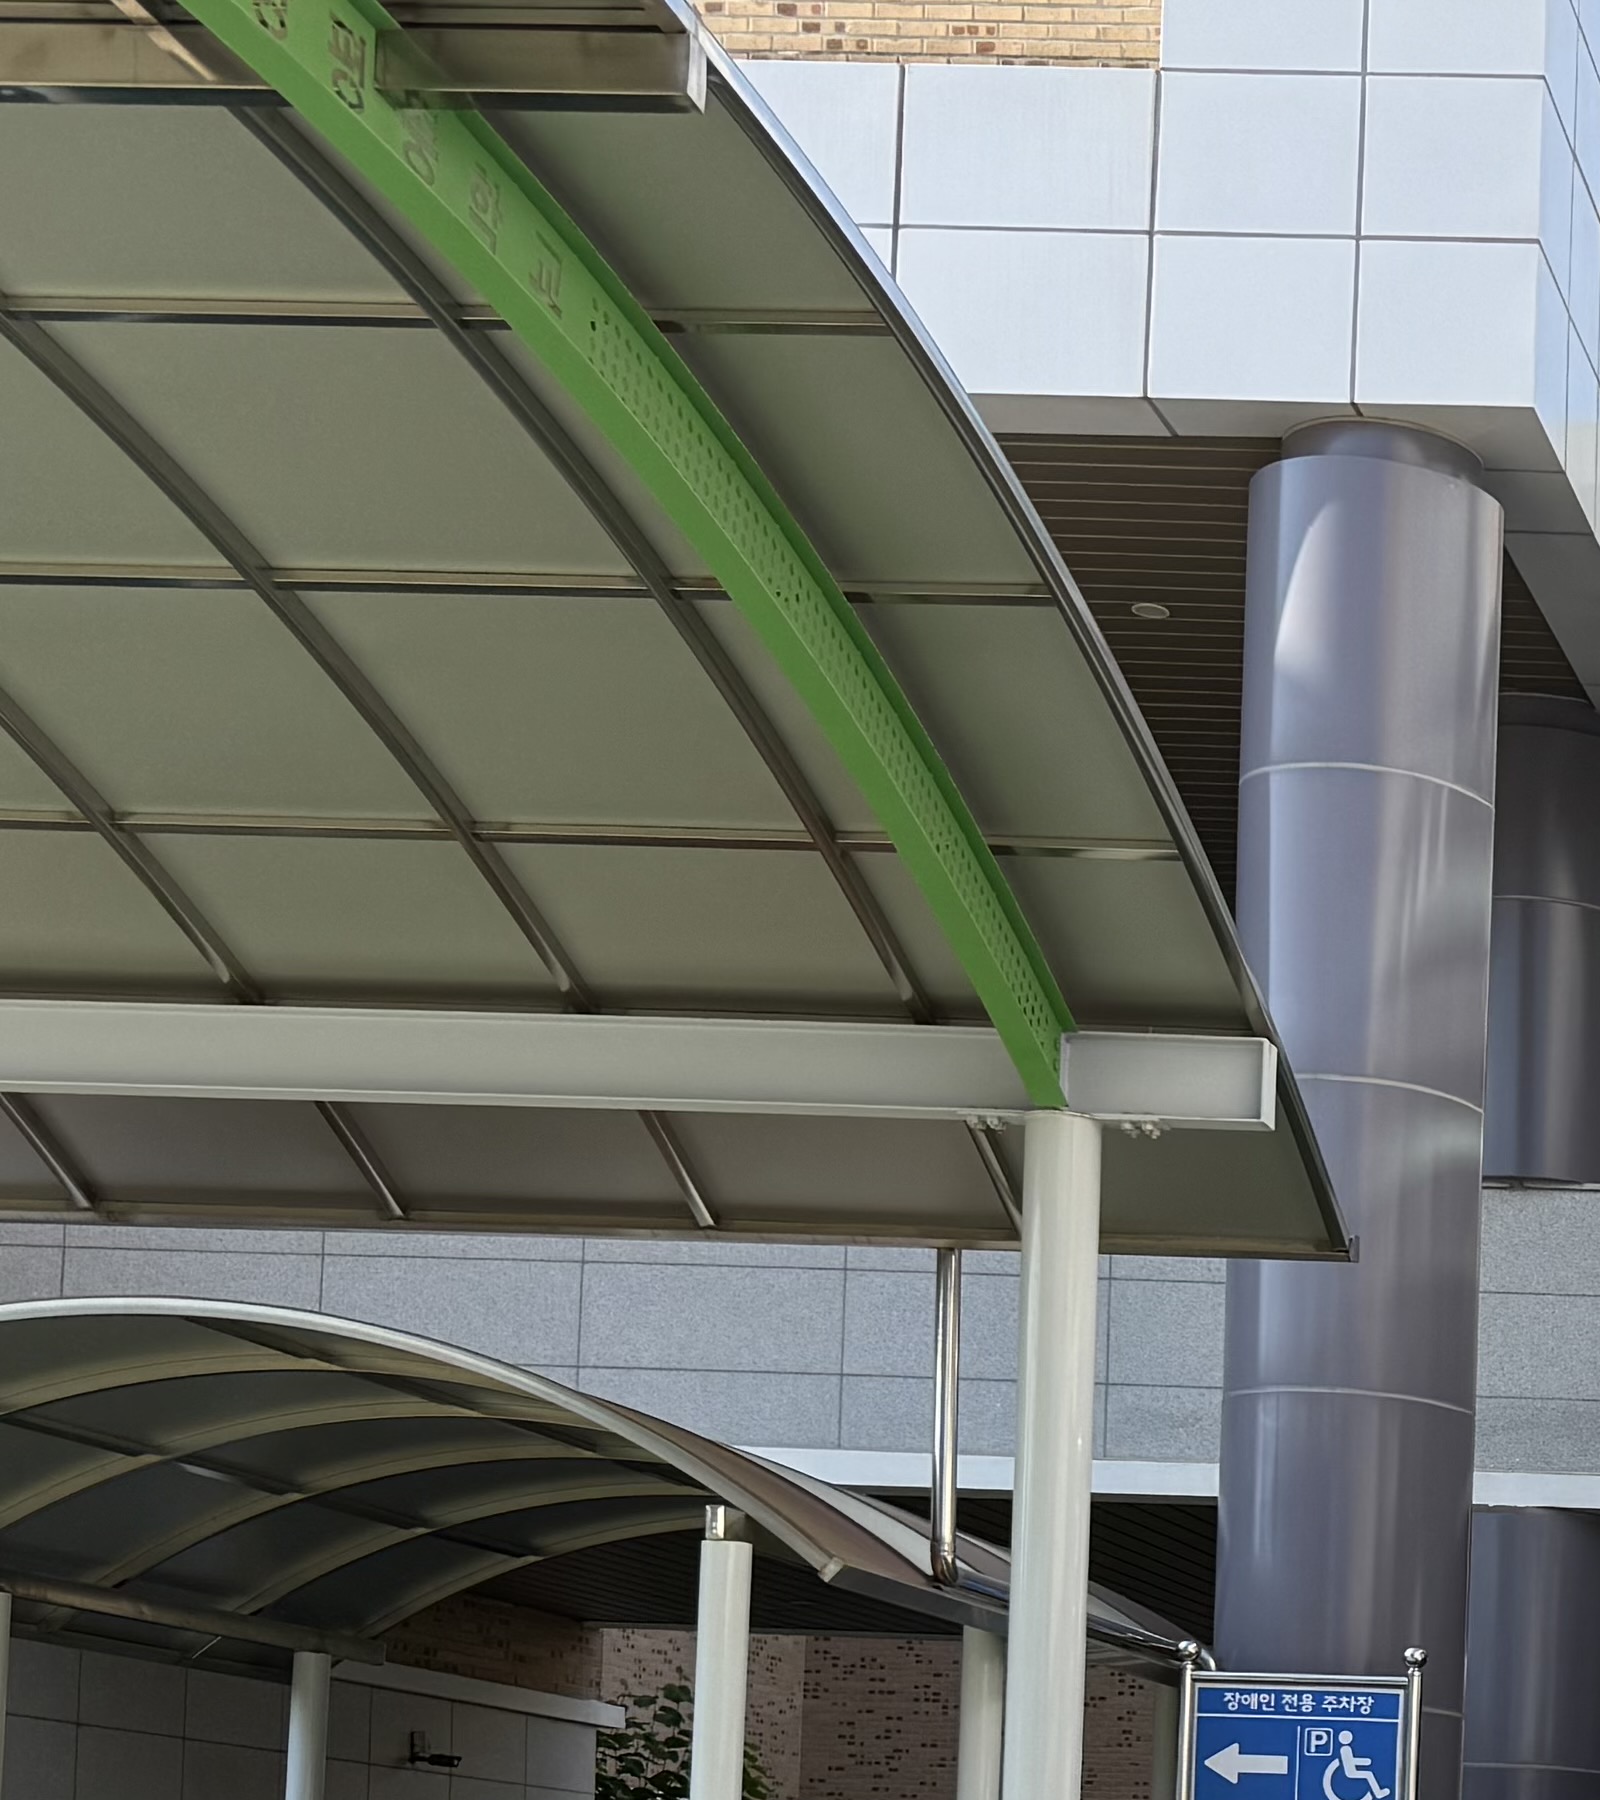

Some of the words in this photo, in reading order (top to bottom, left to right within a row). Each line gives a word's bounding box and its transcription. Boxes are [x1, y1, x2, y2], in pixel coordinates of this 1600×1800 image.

[1223, 1692, 1276, 1712] 장애인
[1281, 1694, 1316, 1713] 전용
[1321, 1695, 1375, 1715] 주차장
[1310, 1731, 1329, 1753] P
